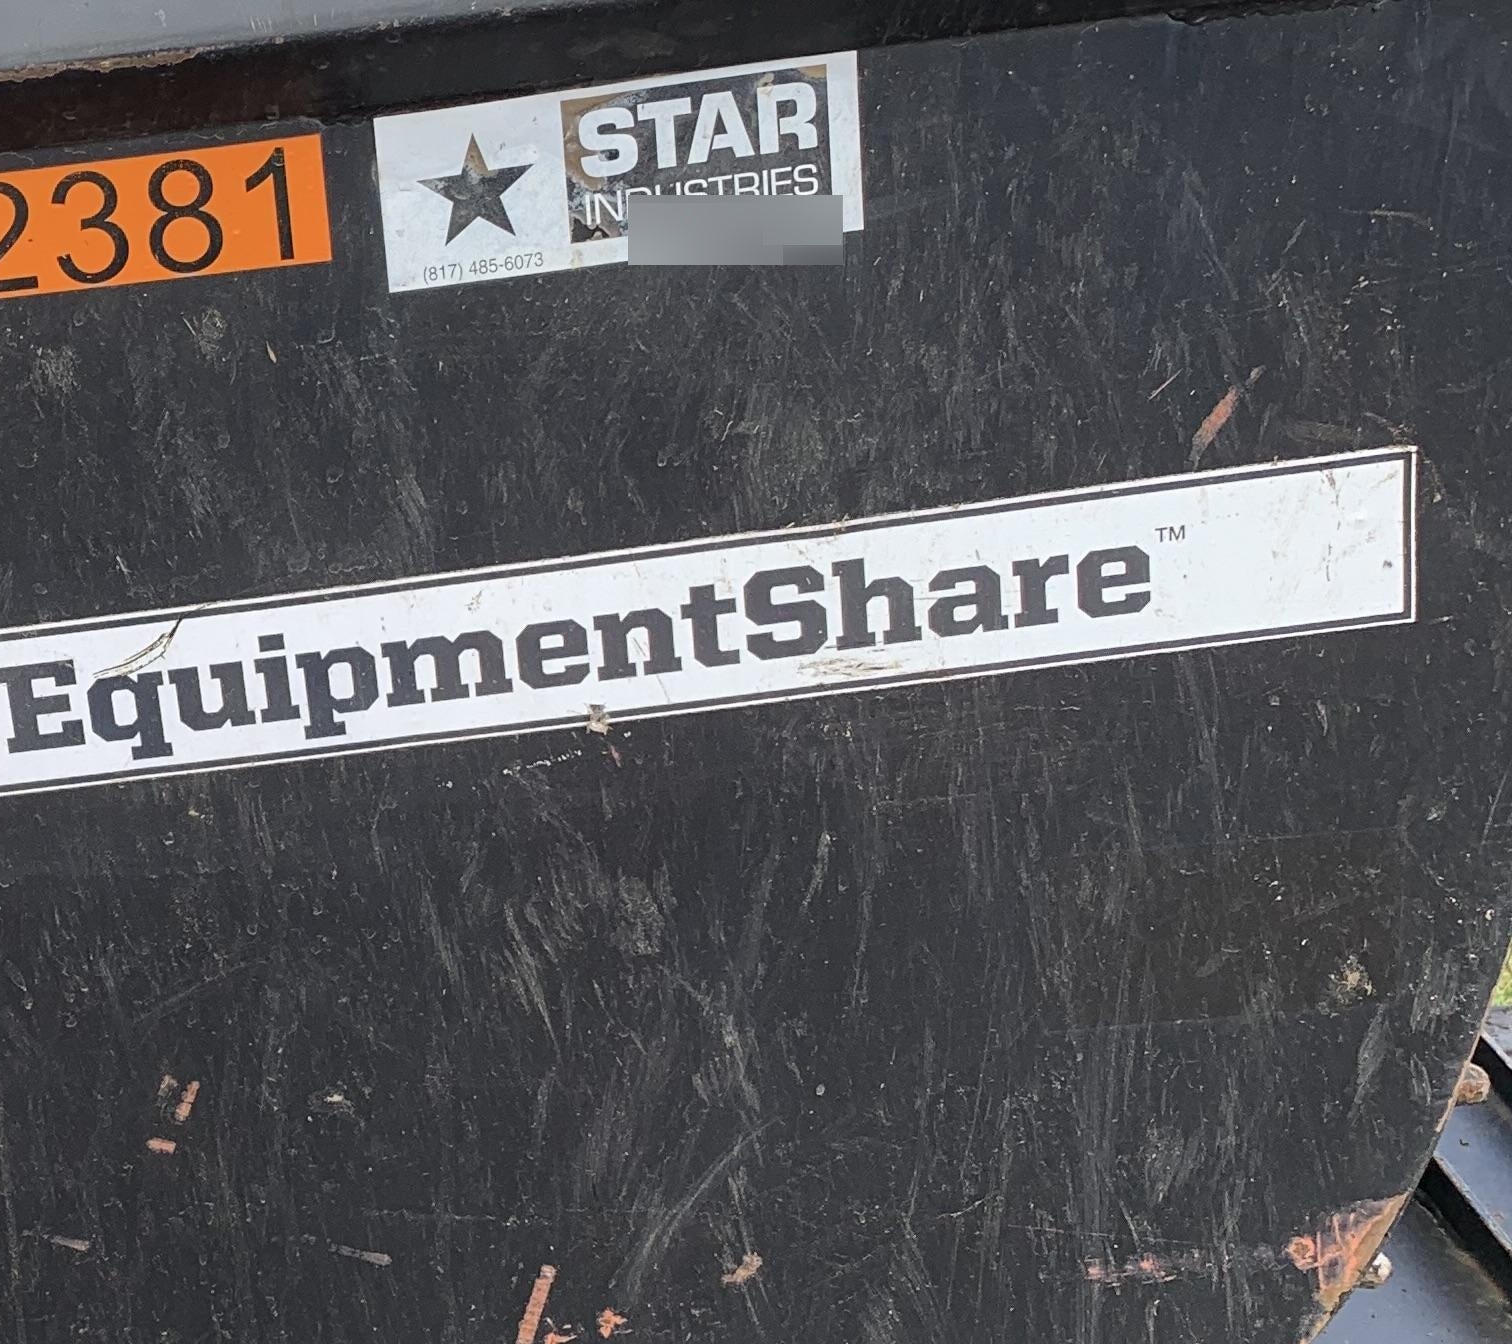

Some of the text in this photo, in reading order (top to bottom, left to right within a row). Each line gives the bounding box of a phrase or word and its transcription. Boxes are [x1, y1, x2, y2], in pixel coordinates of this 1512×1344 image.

[578, 81, 818, 178] STAR
[585, 164, 819, 226] INSTRIES
[423, 252, 545, 285] (817) 485-6073
